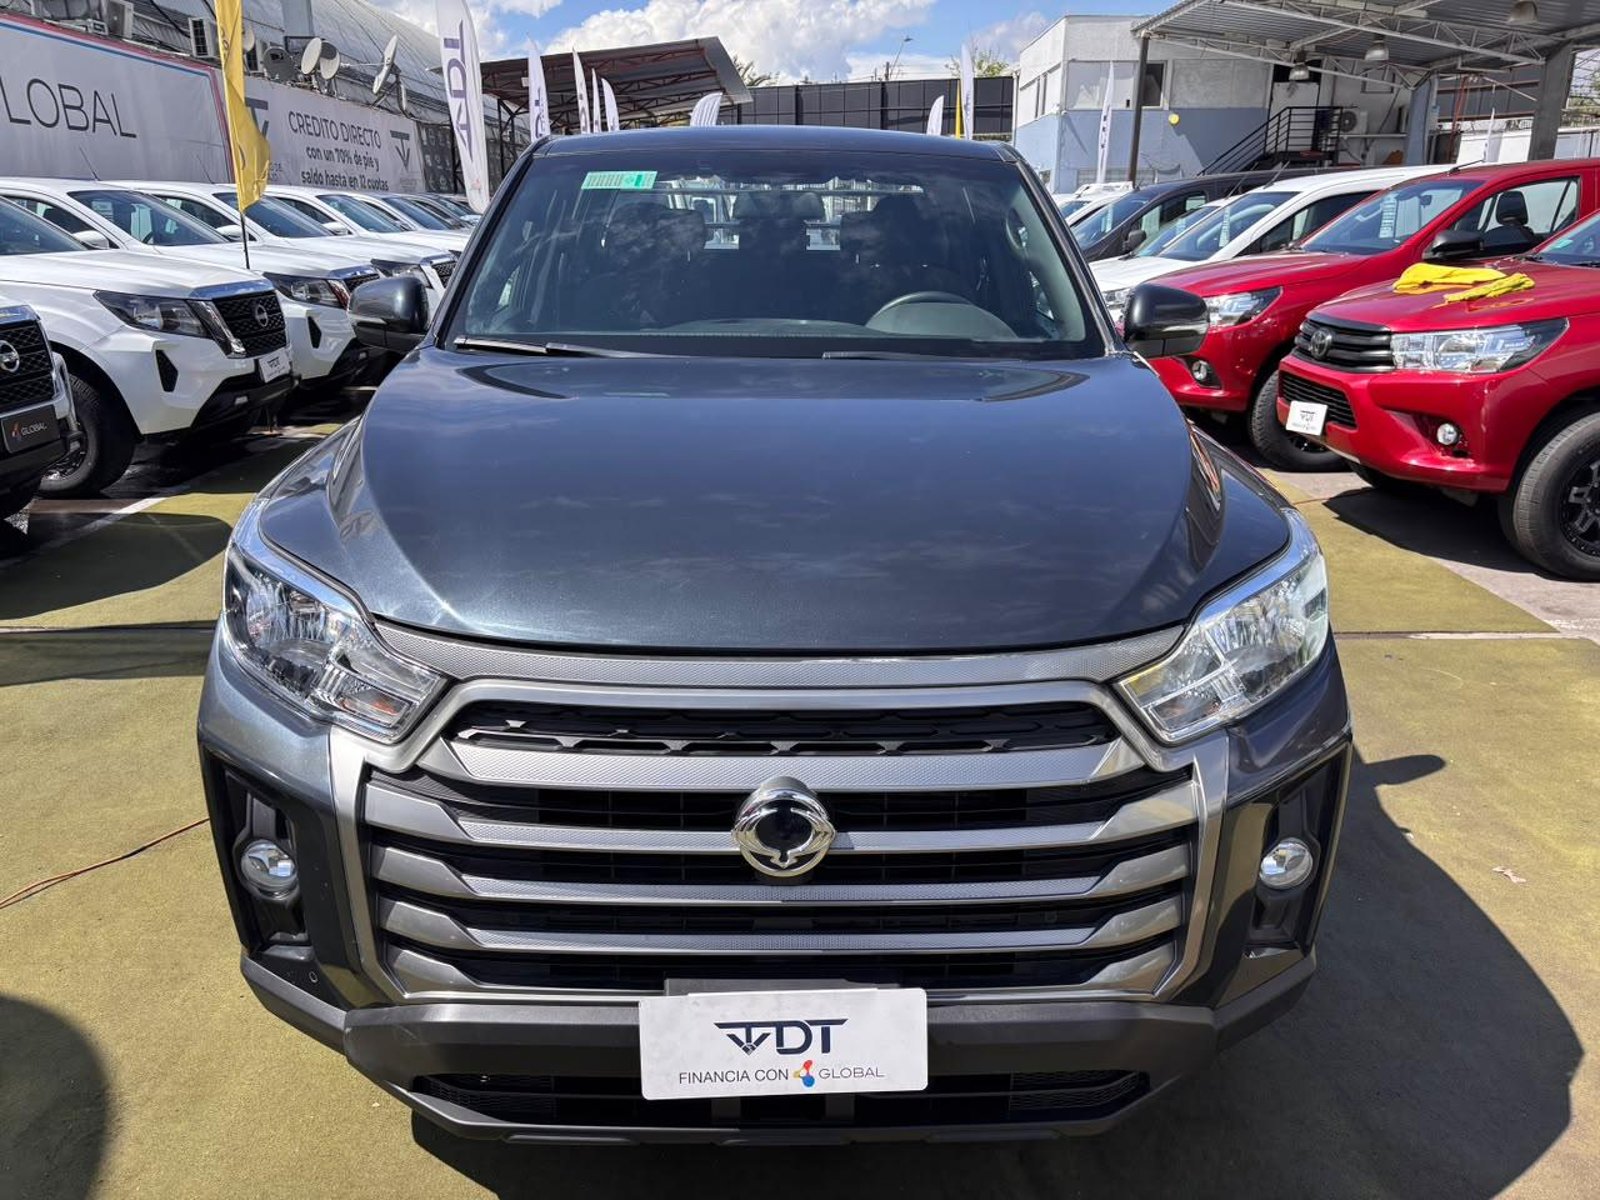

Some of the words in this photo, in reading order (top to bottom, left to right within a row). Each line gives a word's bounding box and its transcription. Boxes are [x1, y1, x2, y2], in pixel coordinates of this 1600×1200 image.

[288, 110, 340, 140] CREDITO
[340, 122, 381, 149] DIRECTO
[306, 146, 323, 161] con
[323, 149, 335, 162] un
[354, 150, 363, 166] de
[363, 152, 374, 170] pie
[301, 168, 323, 185] saldo
[325, 169, 347, 188] hasta
[348, 175, 359, 190] en
[20, 421, 48, 437] GLOBAL
[678, 1069, 750, 1085] FINANCIA
[755, 1067, 789, 1082] CON
[818, 1066, 885, 1080] GLOBAL
